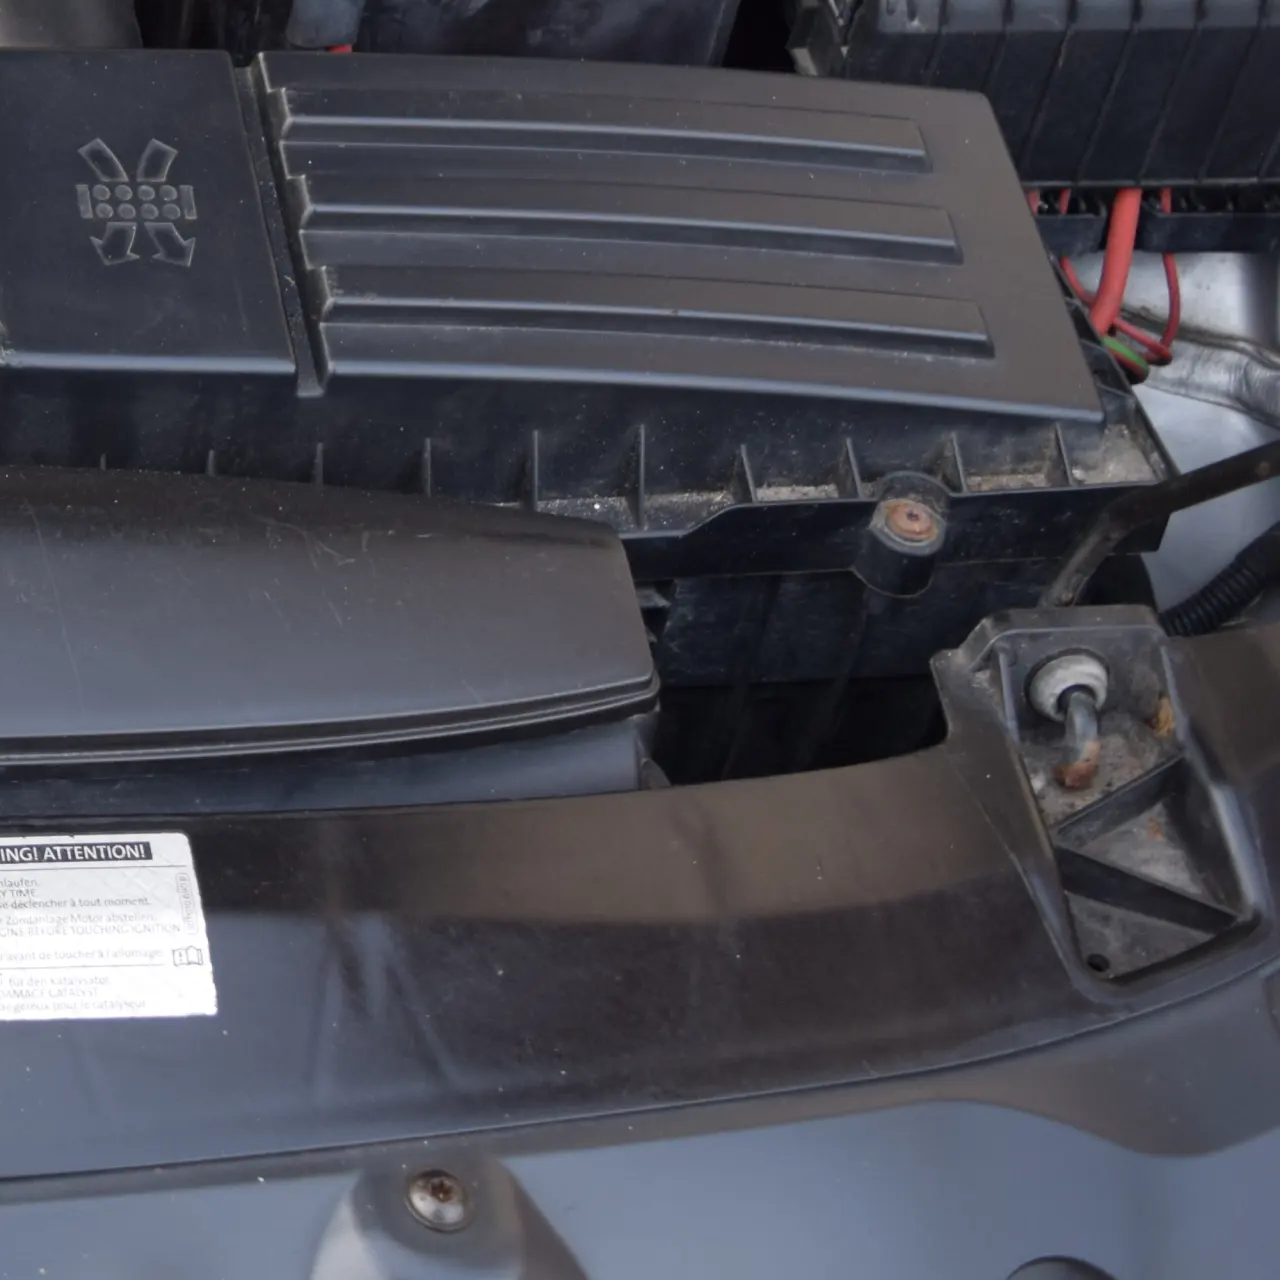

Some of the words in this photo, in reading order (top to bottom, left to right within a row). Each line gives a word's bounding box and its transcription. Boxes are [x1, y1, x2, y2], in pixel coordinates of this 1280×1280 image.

[42, 843, 146, 861] ATTENTION!
[10, 898, 68, 910] déclencher
[70, 897, 77, 907] à
[78, 897, 101, 907] tout
[71, 912, 104, 924] Motor
